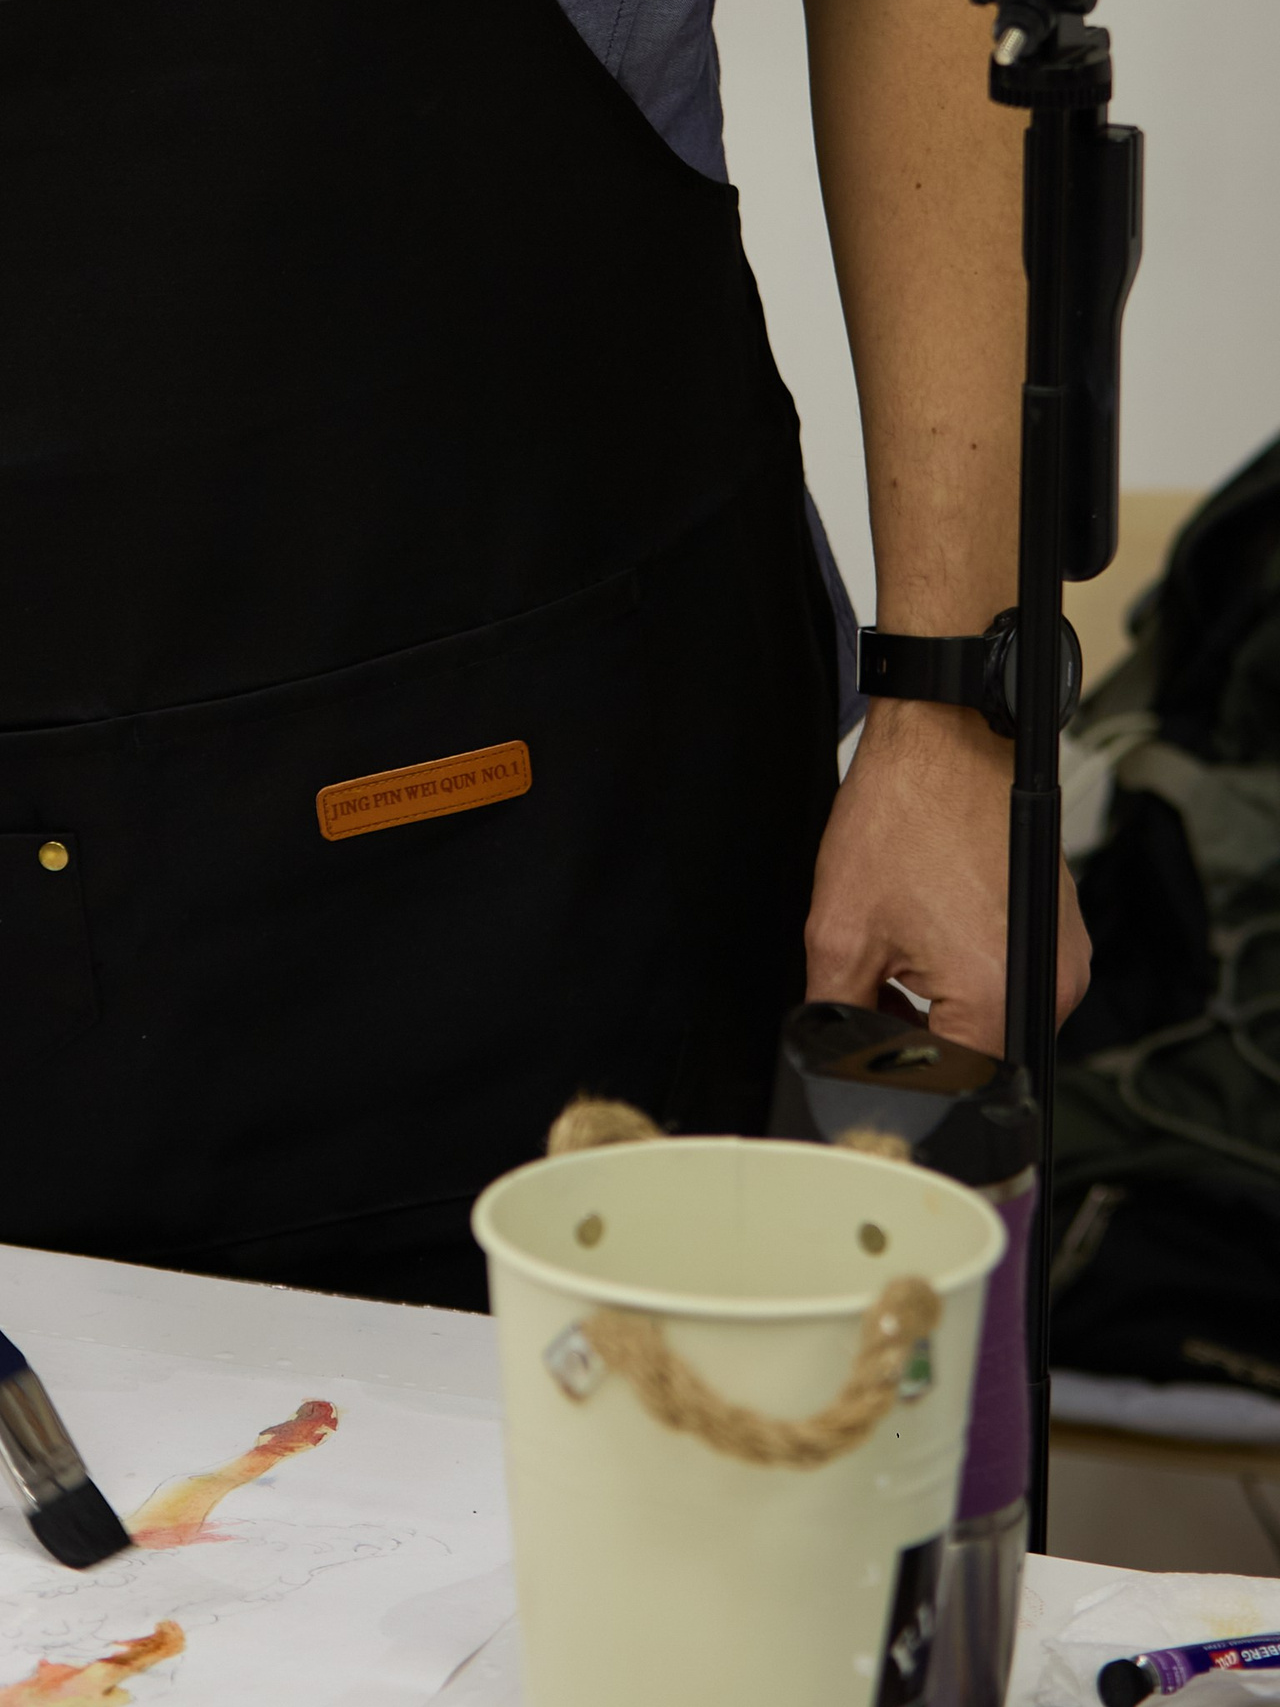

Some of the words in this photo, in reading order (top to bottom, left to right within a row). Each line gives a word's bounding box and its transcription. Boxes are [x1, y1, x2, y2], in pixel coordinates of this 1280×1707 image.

[331, 797, 370, 821] JING
[373, 788, 402, 808] PIN
[404, 780, 437, 801] WEI
[440, 771, 477, 793] QUN
